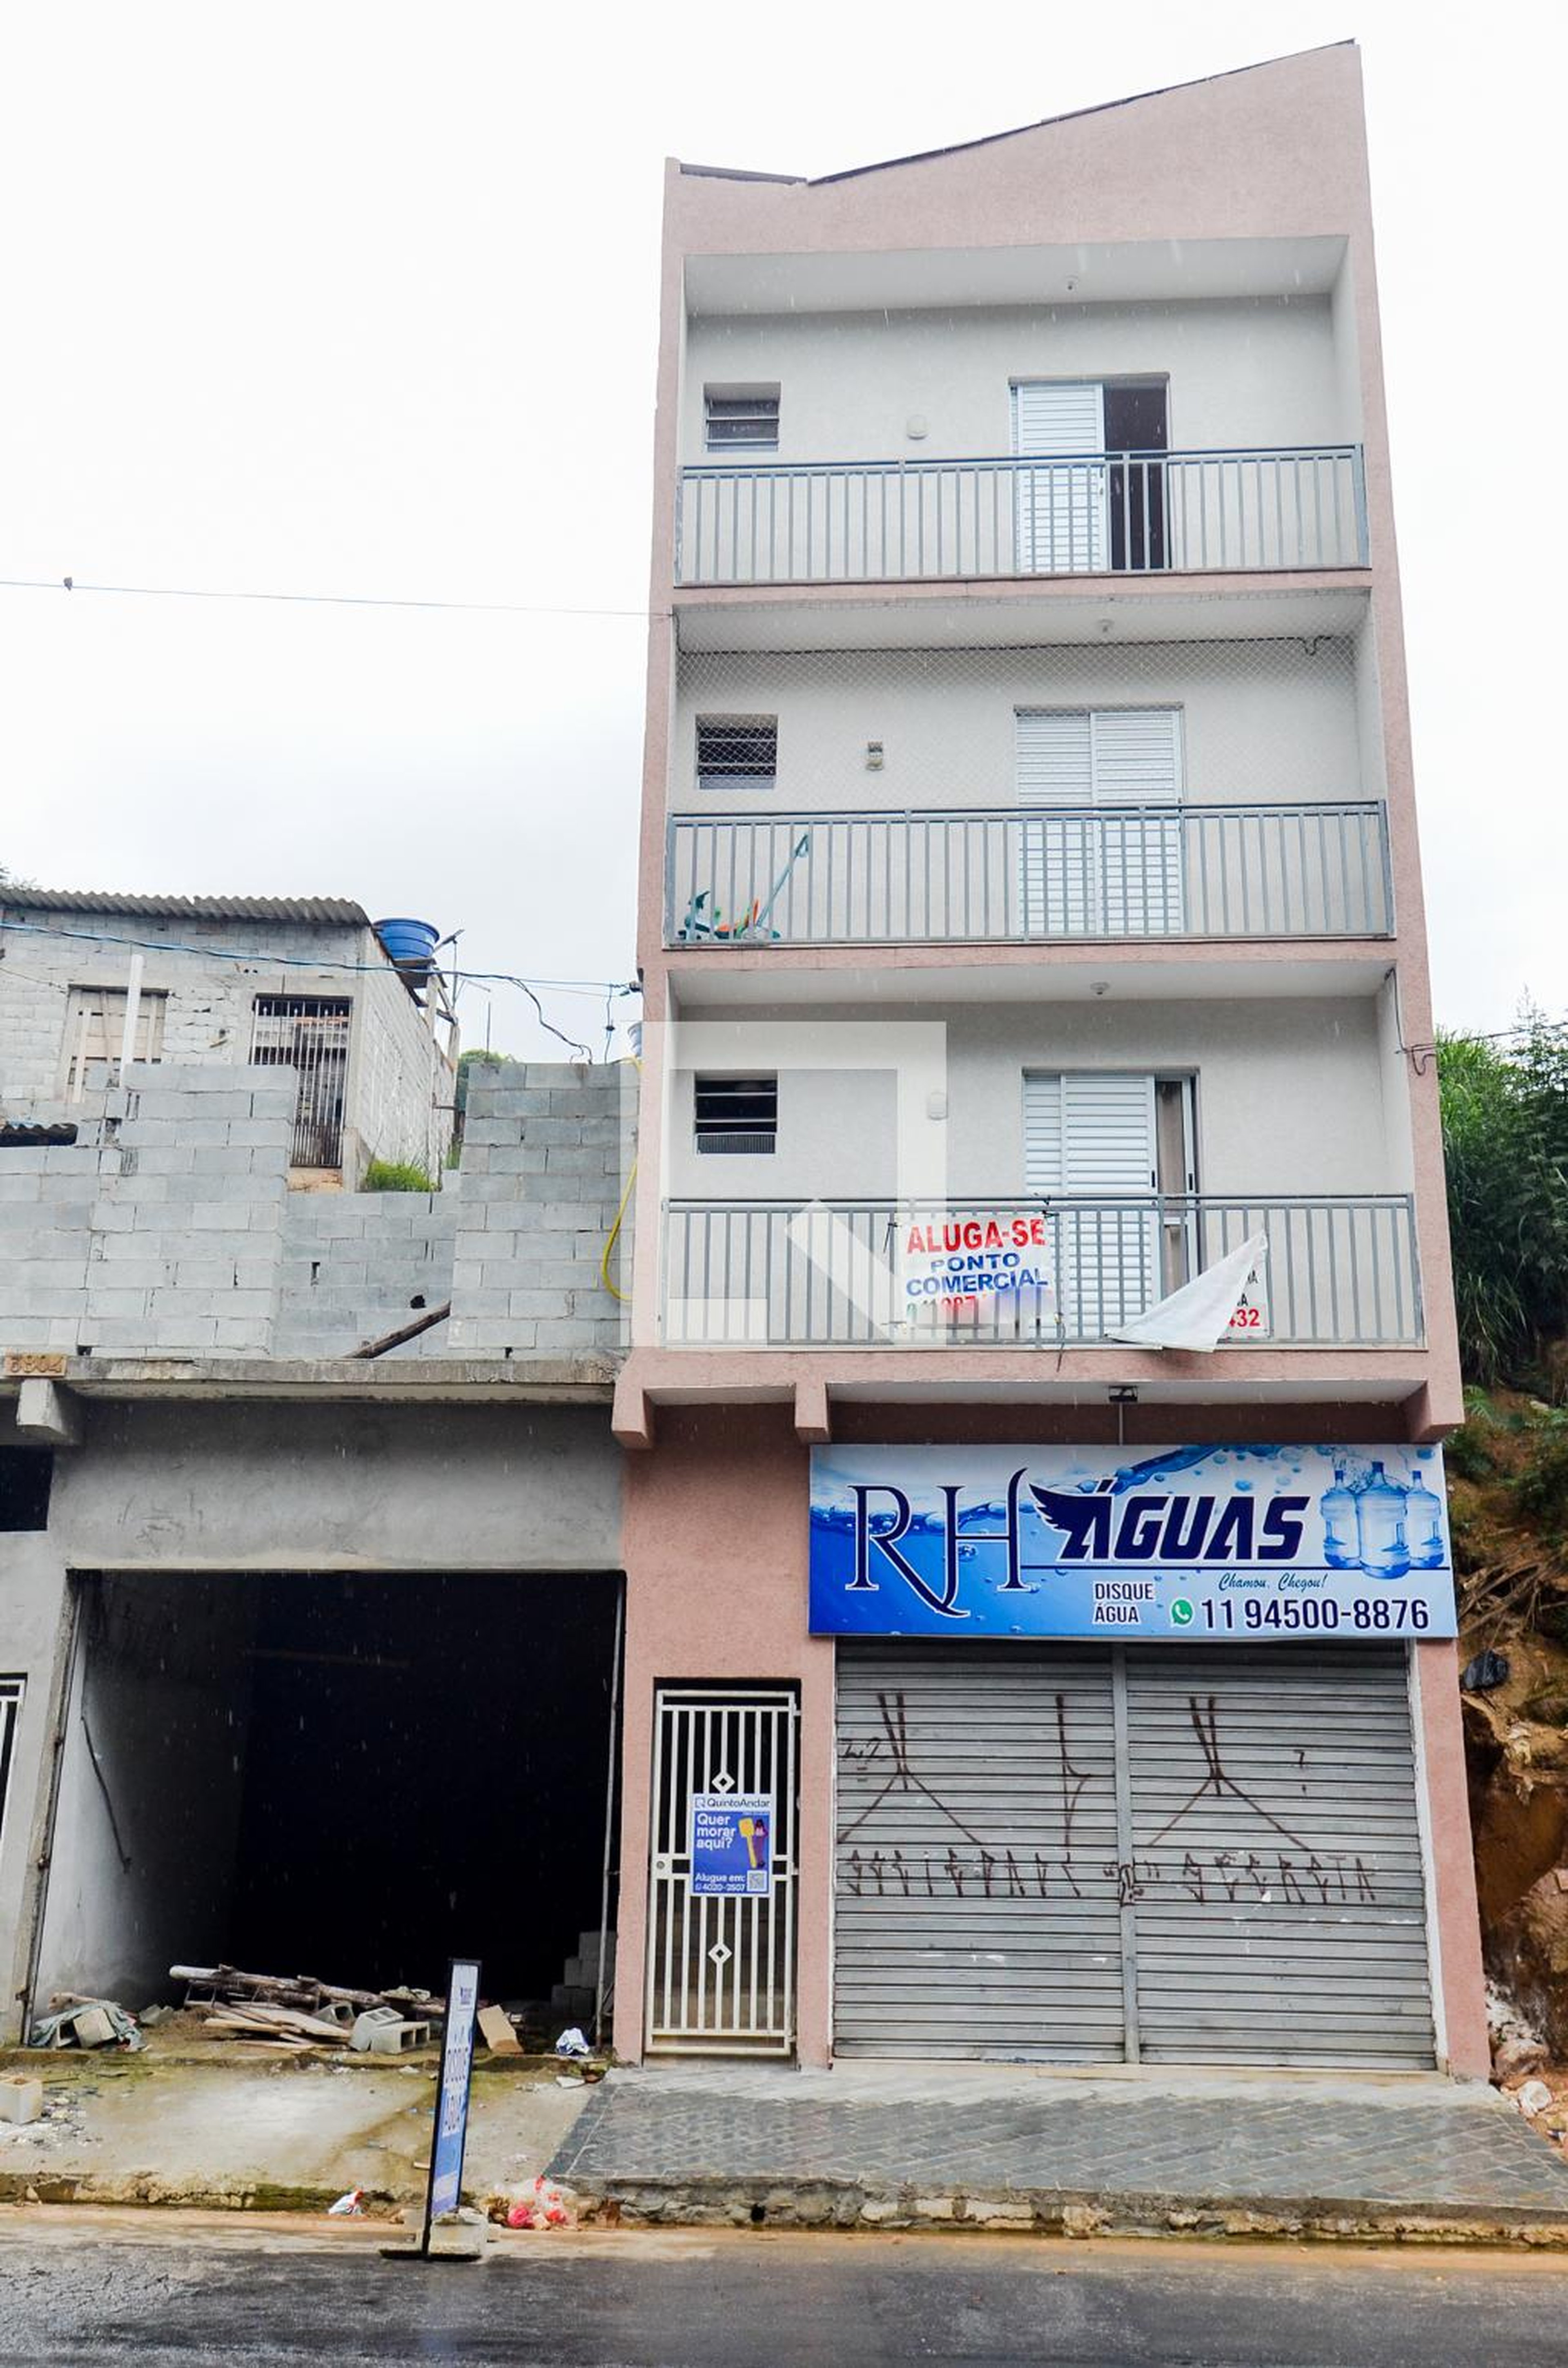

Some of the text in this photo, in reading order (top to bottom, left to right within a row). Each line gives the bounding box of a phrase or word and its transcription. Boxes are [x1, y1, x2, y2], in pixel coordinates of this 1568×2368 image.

[907, 1218, 1047, 1254] ALUGA-SE
[931, 1252, 1020, 1273] PONTO
[906, 1268, 1048, 1296] COMERCIAL
[845, 1467, 1310, 1617] RH ÁGUAS
[1095, 1583, 1154, 1601] DISQUE
[1278, 1572, 1328, 1592] Chegou!
[1094, 1603, 1139, 1623] ÁGUA
[1201, 1598, 1429, 1629] 11 94500-8876
[707, 1797, 770, 1807] QuintoAndar
[697, 1813, 731, 1826] Quer
[697, 1827, 736, 1837] morar
[696, 1837, 733, 1850] aqui?
